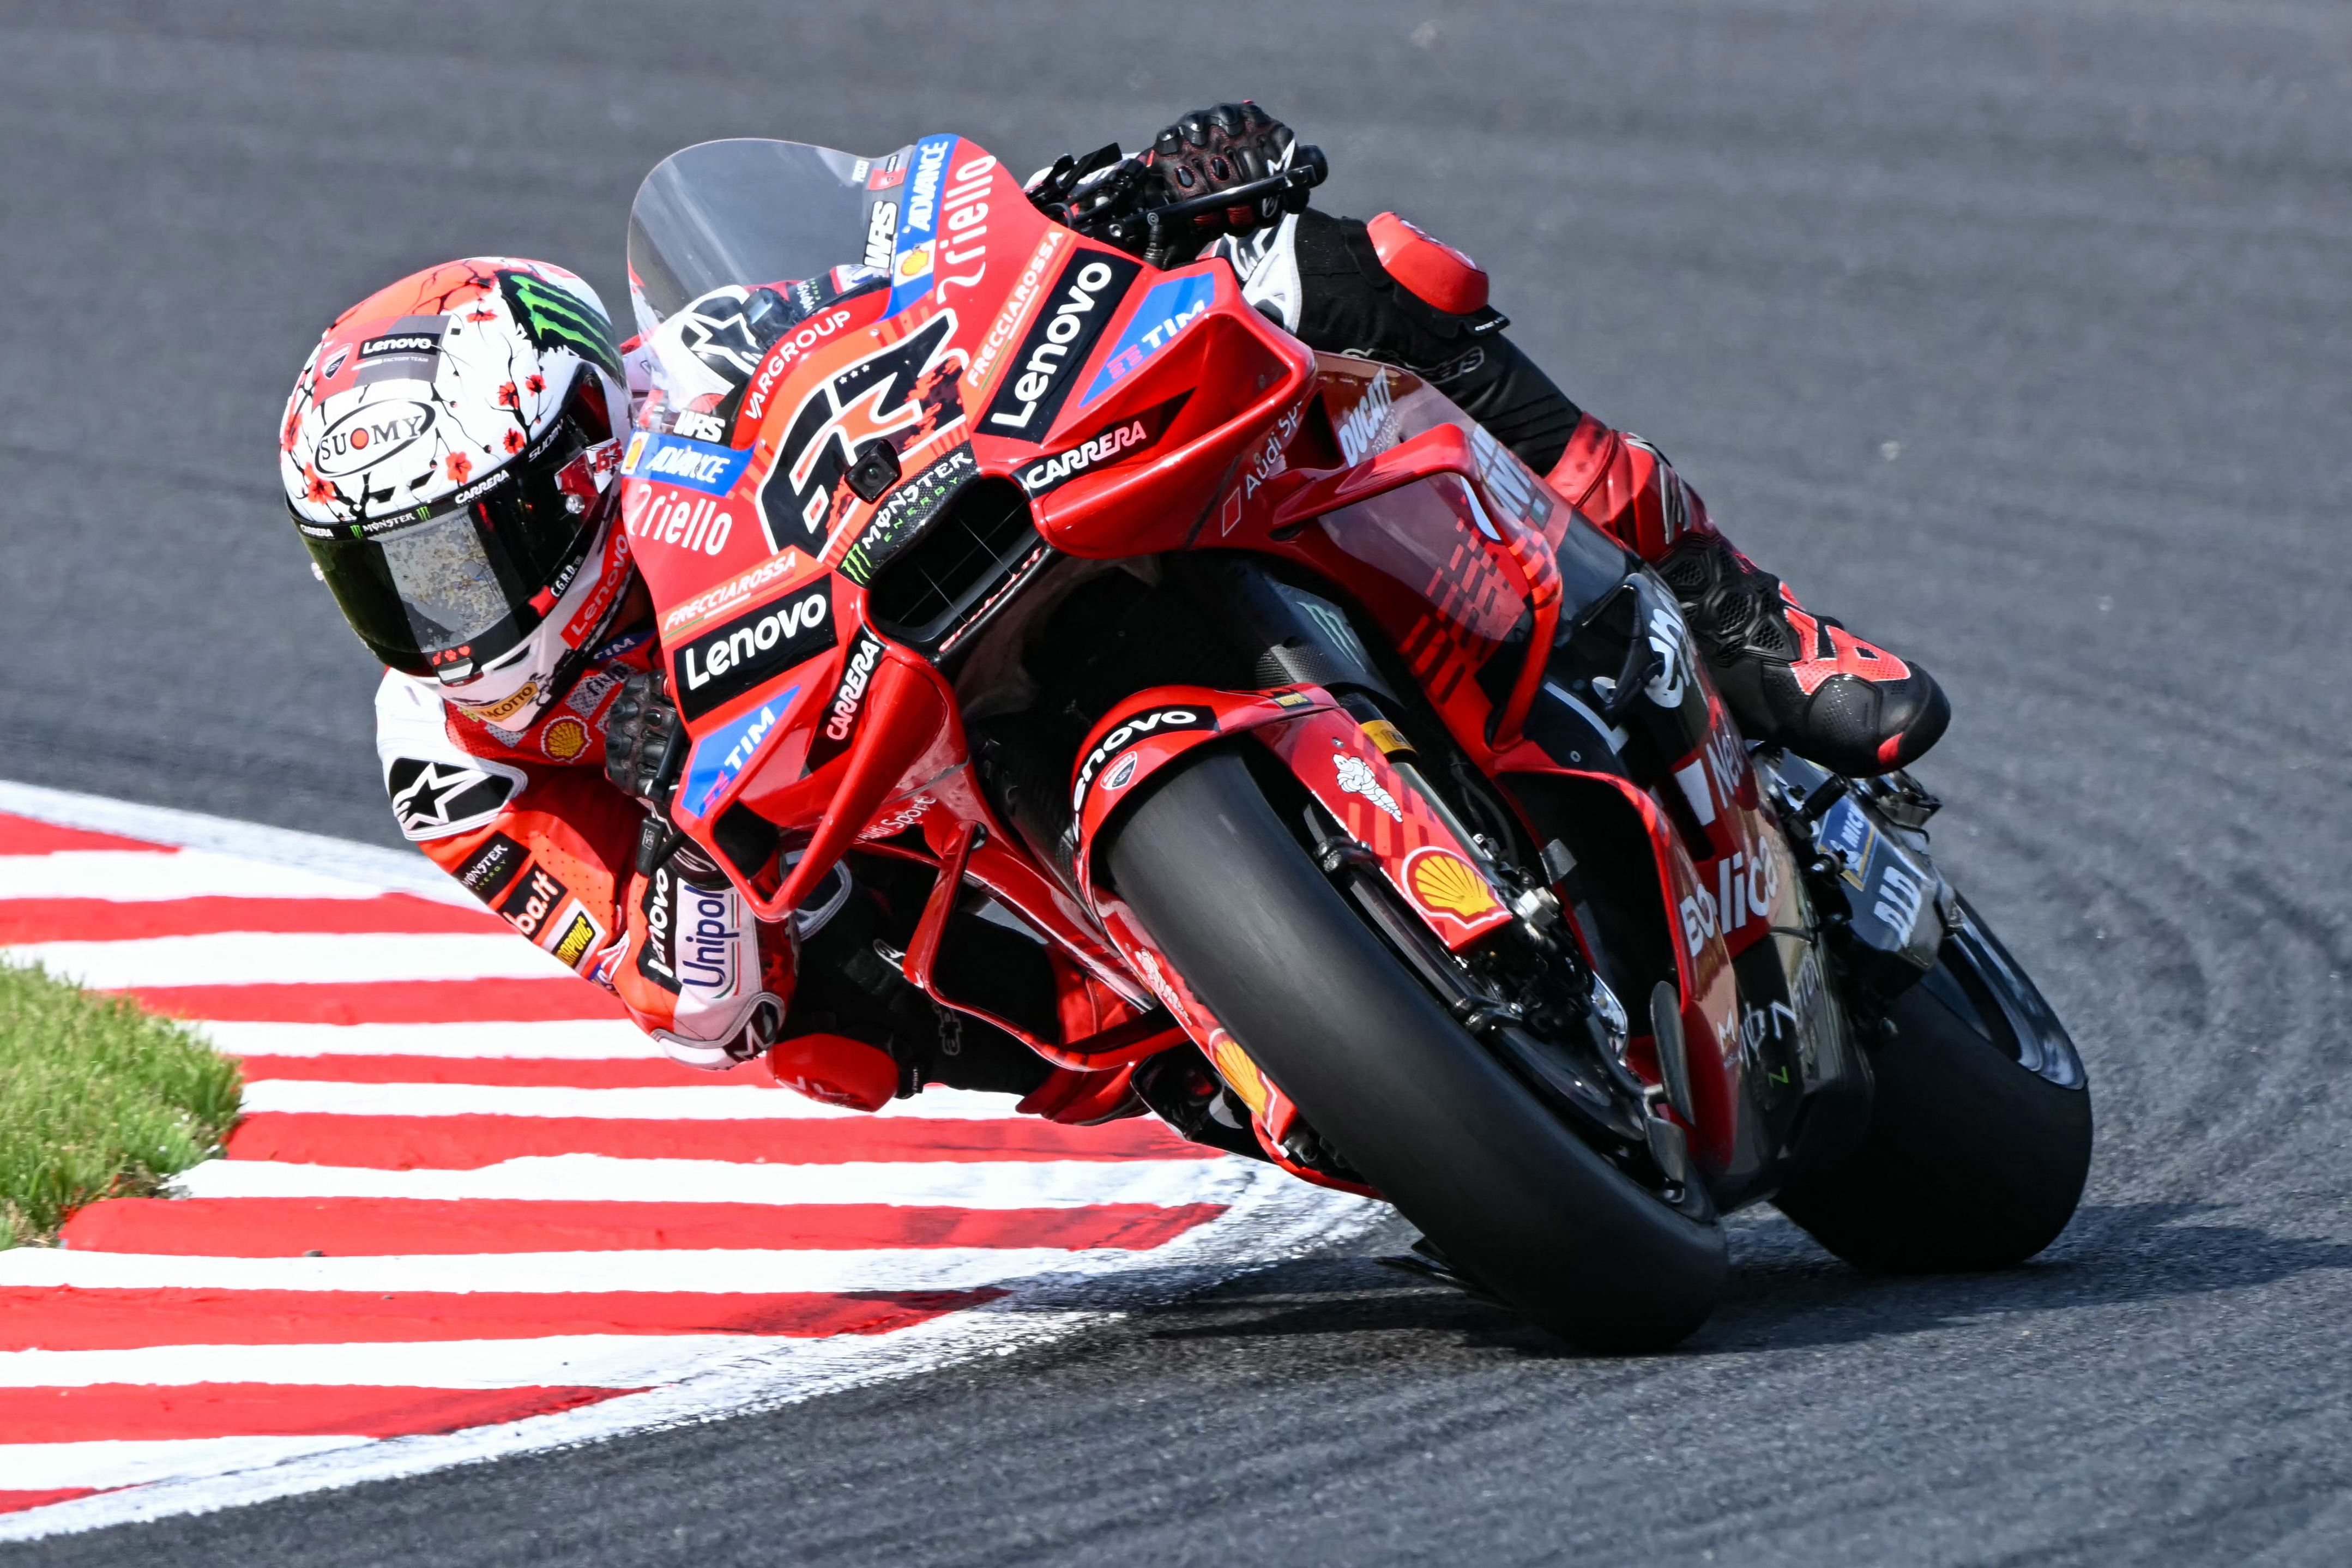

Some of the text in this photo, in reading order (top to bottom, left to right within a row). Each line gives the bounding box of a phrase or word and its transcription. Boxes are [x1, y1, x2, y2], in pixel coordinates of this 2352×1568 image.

[908, 141, 948, 232] ADVANCE
[939, 155, 997, 265] riello
[864, 201, 897, 269] WRS
[967, 231, 1063, 387] FRECCIAROSSA
[1141, 299, 1205, 348] TIM
[363, 338, 431, 354] Lenovo
[745, 310, 851, 419] VARGROUP
[991, 262, 1113, 429] Lenovo
[319, 415, 422, 460] SUOMY
[595, 441, 624, 473] 63
[673, 409, 726, 443] WRS
[1026, 420, 1147, 488] CARRERA
[455, 469, 509, 504] CARRERA
[646, 445, 731, 484] ADVANCE
[1246, 431, 1282, 499] Audi
[300, 524, 334, 538] CARRERA
[652, 490, 732, 556] riello
[571, 534, 628, 636] Lenovo
[664, 551, 797, 631] FRECCIAROSSA
[685, 594, 826, 691] Lenovo
[826, 636, 879, 741] CARRERA
[725, 706, 776, 771] TIM
[1072, 711, 1197, 842] Lenovo
[880, 797, 938, 829] Sport
[502, 870, 559, 936] ba.it
[682, 884, 740, 988] Unipol
